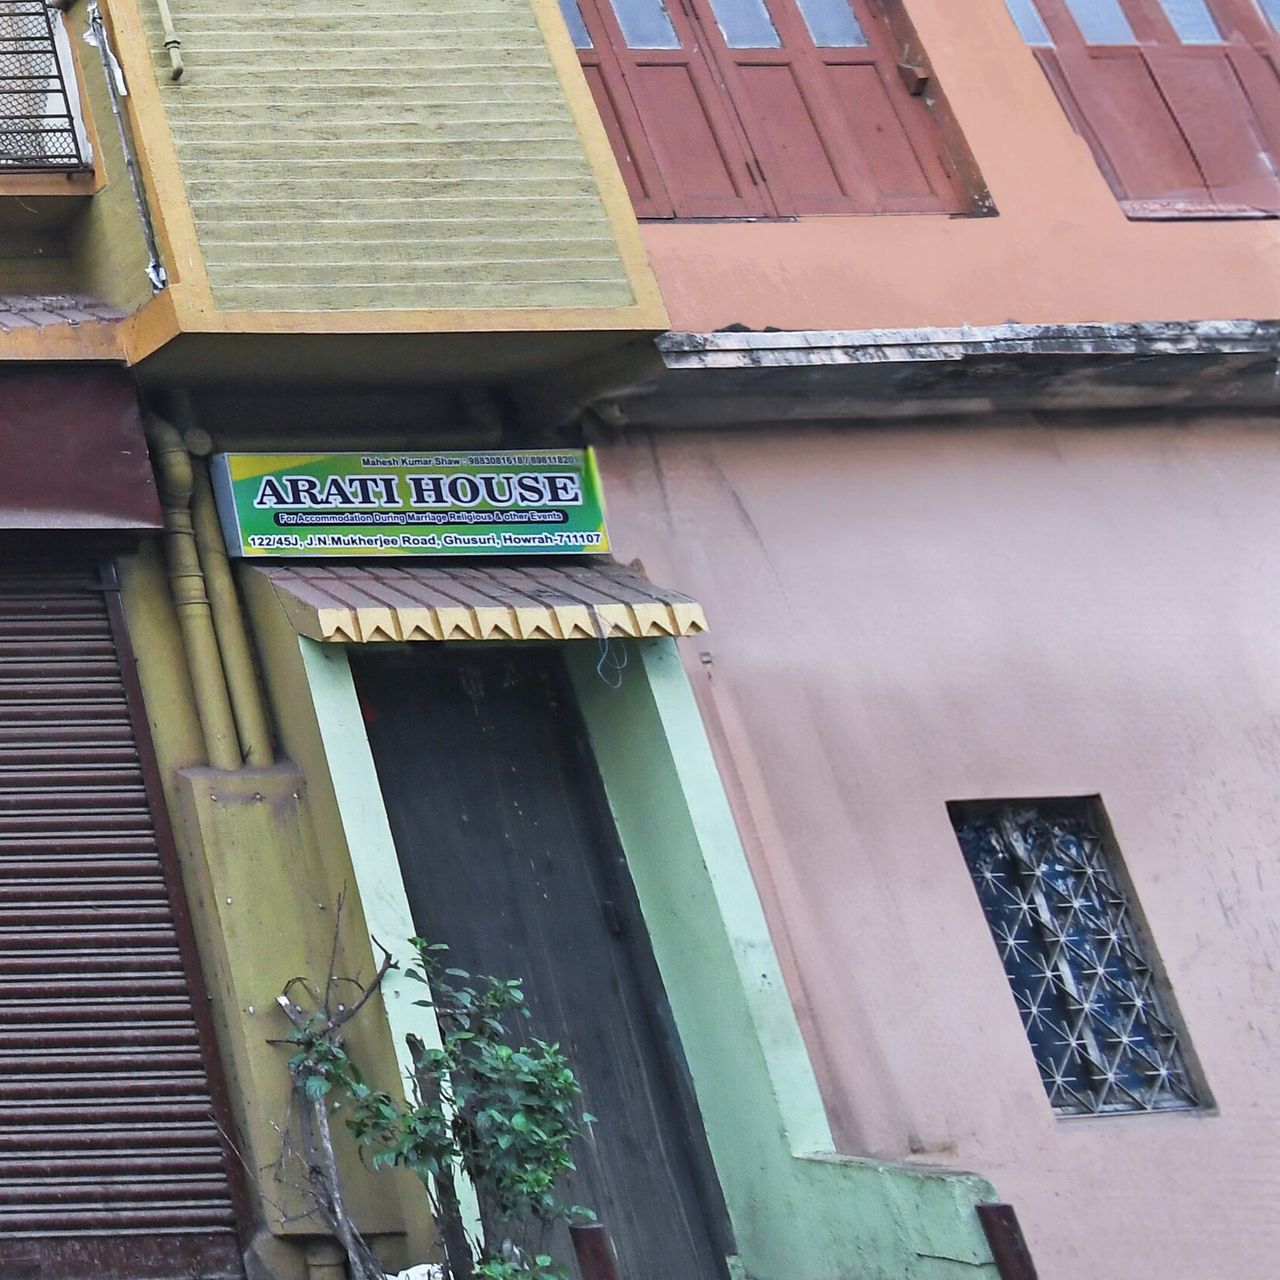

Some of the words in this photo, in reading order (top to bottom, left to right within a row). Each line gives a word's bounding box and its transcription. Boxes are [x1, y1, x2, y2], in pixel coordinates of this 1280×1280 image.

[361, 457, 399, 467] Mahesh
[401, 457, 432, 466] Kumar
[255, 477, 401, 506] ARATI
[408, 475, 580, 504] HOUSE
[279, 513, 296, 523] For
[297, 512, 373, 524] Accommodation
[374, 512, 406, 524] During
[407, 512, 447, 524] Marriage
[448, 511, 493, 524] Religious
[493, 511, 502, 522] &
[503, 511, 529, 522] other
[529, 511, 563, 522] Events
[249, 535, 303, 548] 122/45J,
[401, 535, 441, 548] Road,
[443, 534, 500, 547] Ghusuri,
[502, 532, 601, 545] Howrah-711107
